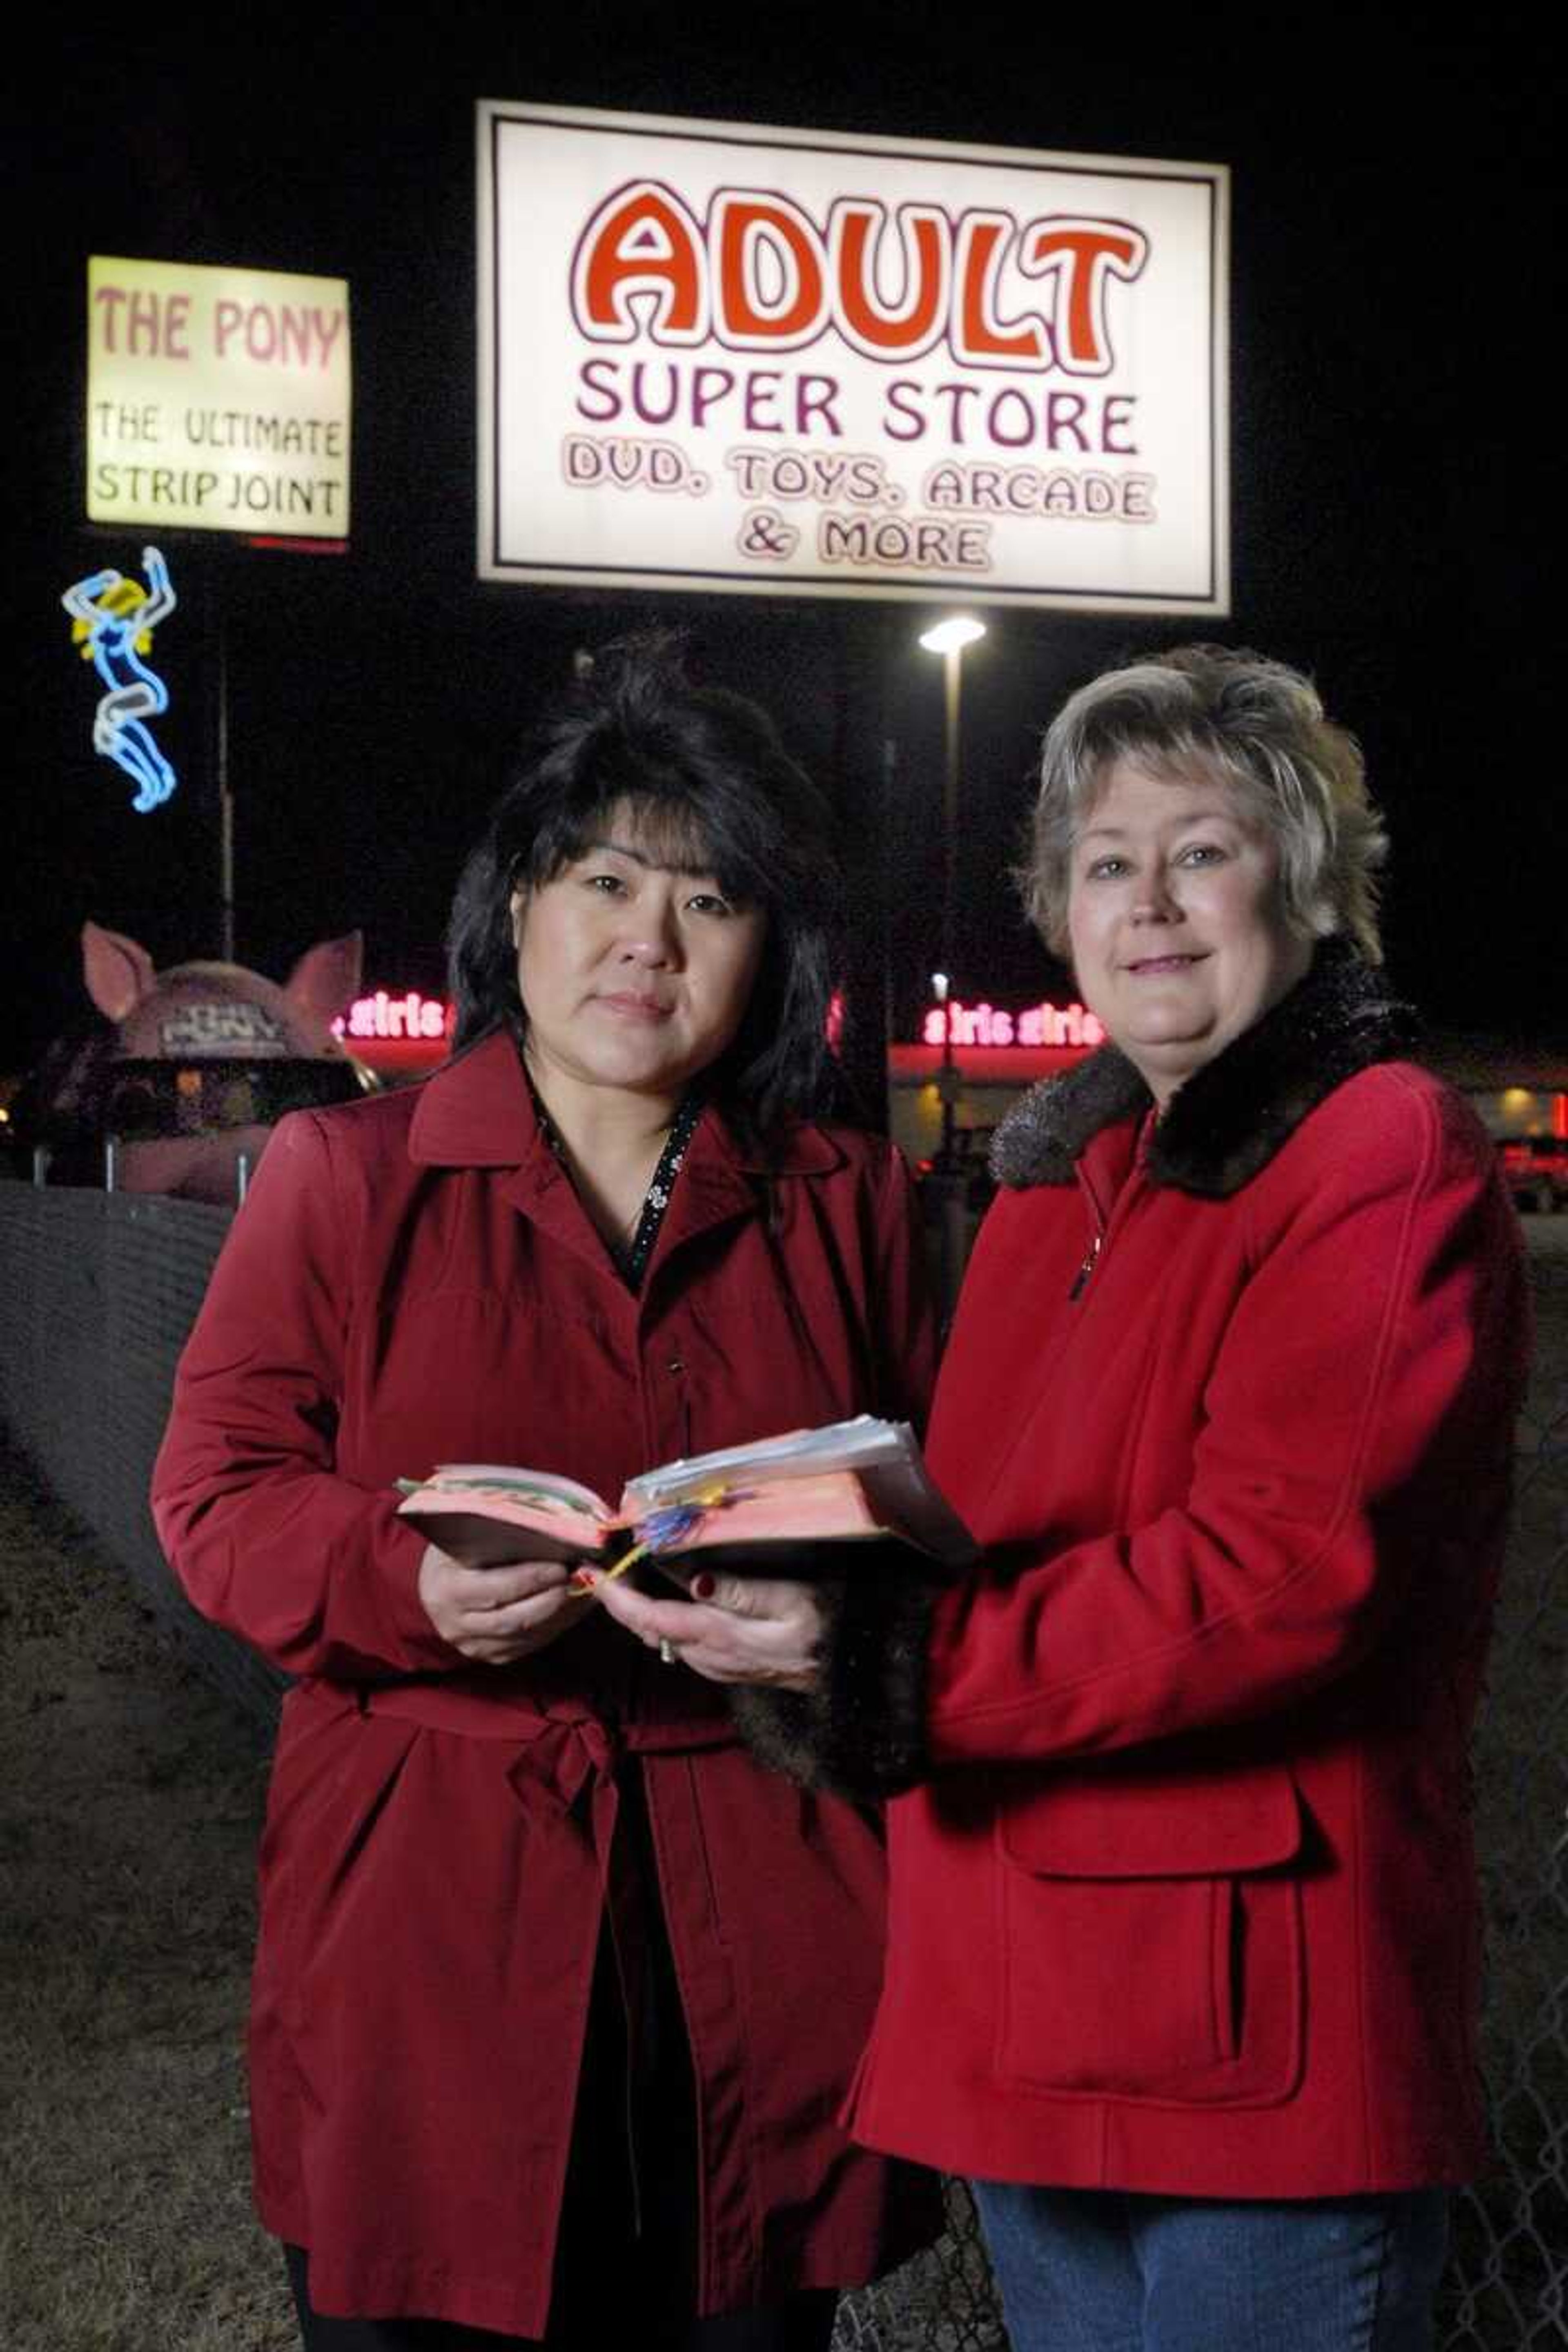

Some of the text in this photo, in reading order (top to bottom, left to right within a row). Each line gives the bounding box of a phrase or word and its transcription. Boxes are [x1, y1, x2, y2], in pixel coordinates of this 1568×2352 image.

[569, 179, 1149, 376] ADULT
[94, 286, 344, 368] THE PONY
[96, 402, 342, 457] THE ULTIMATE
[577, 359, 1138, 454] SUPER STORE
[95, 464, 342, 517] STRIP JOINT
[924, 462, 1156, 521] ARCADE
[739, 510, 991, 569] & MORE
